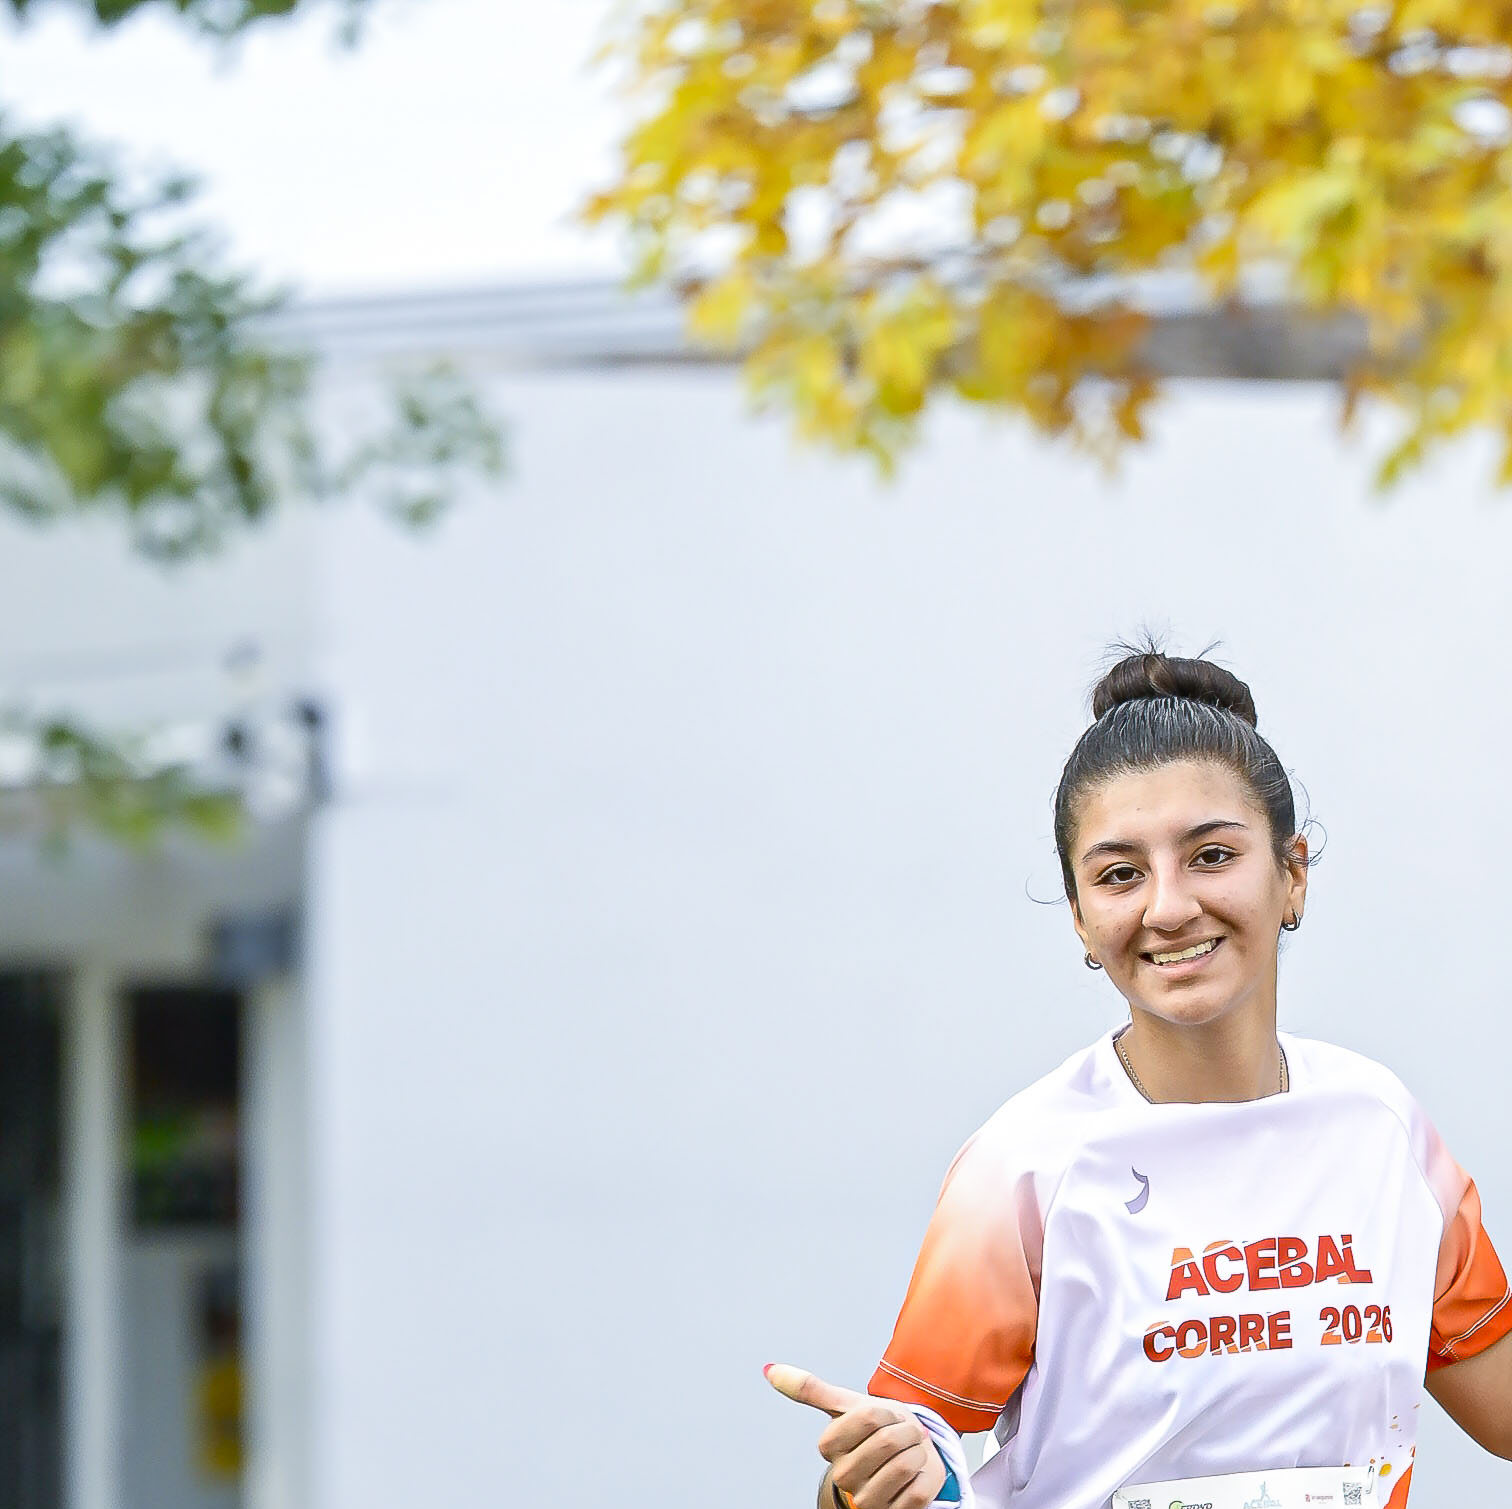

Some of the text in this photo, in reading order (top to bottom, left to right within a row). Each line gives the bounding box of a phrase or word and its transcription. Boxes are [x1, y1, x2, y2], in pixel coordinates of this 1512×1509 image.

[1165, 1234, 1373, 1301] ACEBAL
[1142, 1304, 1393, 1362] CORRE 2026
